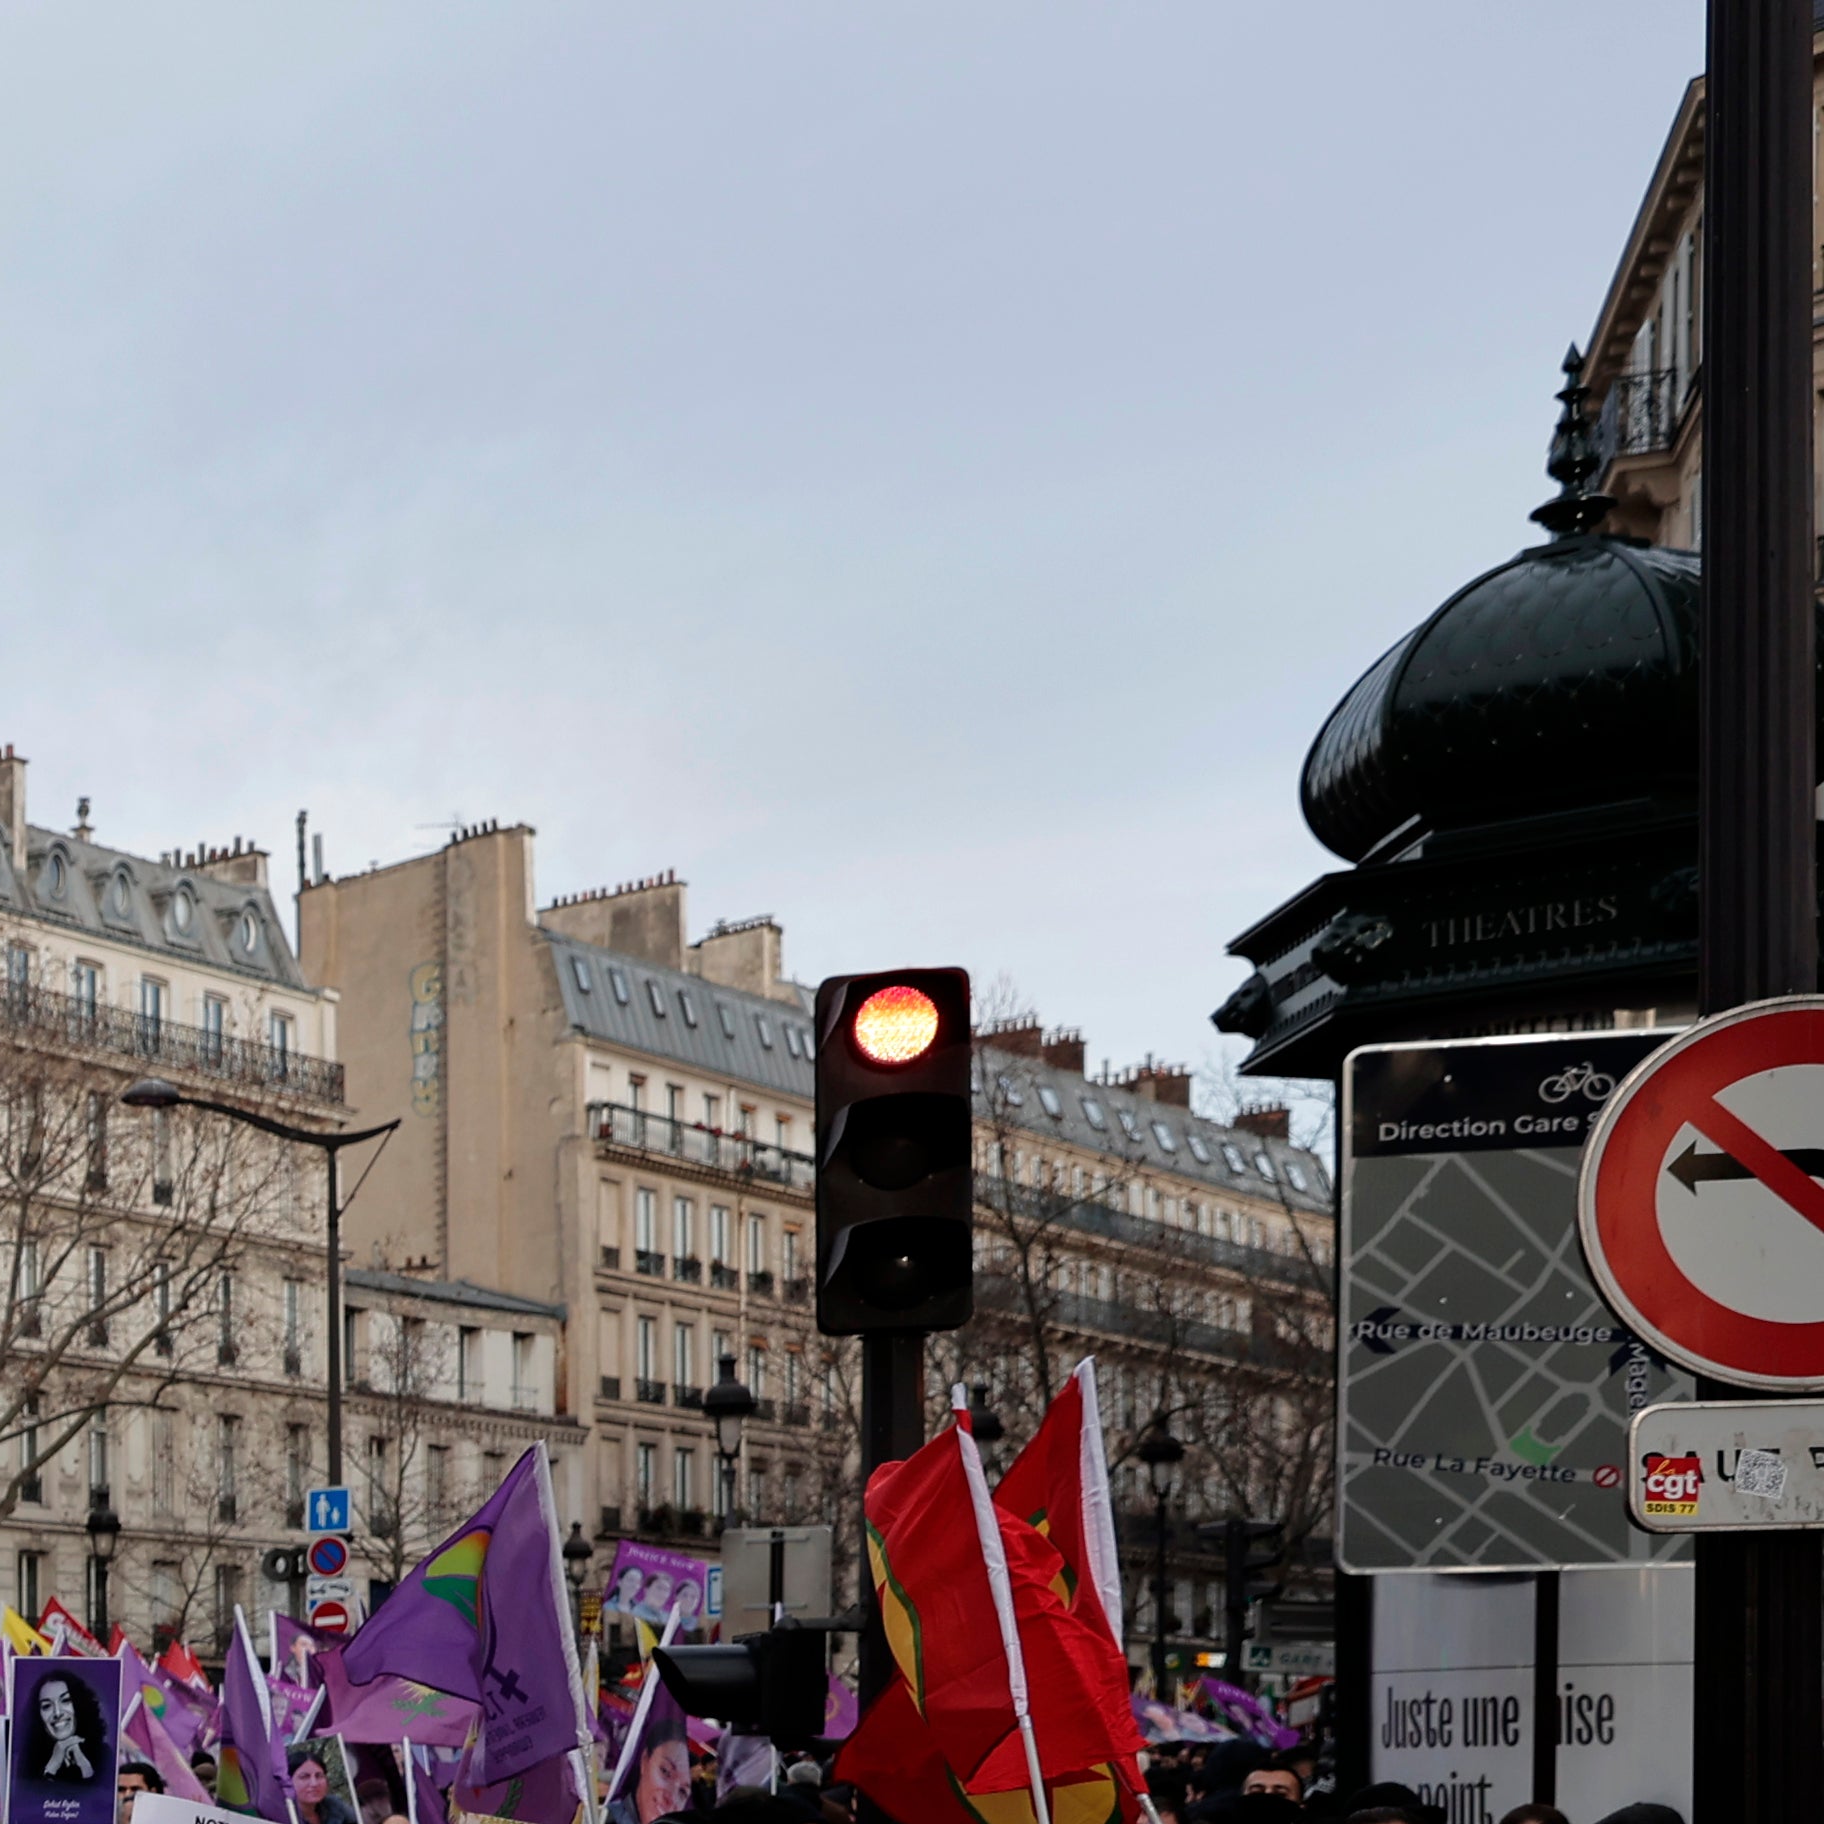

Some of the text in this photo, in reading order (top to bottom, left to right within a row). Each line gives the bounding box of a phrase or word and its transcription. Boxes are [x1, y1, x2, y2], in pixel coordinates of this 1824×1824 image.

[1421, 895, 1620, 949] THEATRES
[1377, 1116, 1507, 1143] Direction
[1513, 1113, 1580, 1135] Gare
[1356, 1320, 1613, 1345] Rue de Maubeuge
[1372, 1447, 1577, 1485] Rue La Fayette
[1646, 1469, 1698, 1500] cgt
[1645, 1503, 1696, 1514] SDIS 77
[1381, 1686, 1453, 1750] Juste
[1462, 1694, 1521, 1748] une
